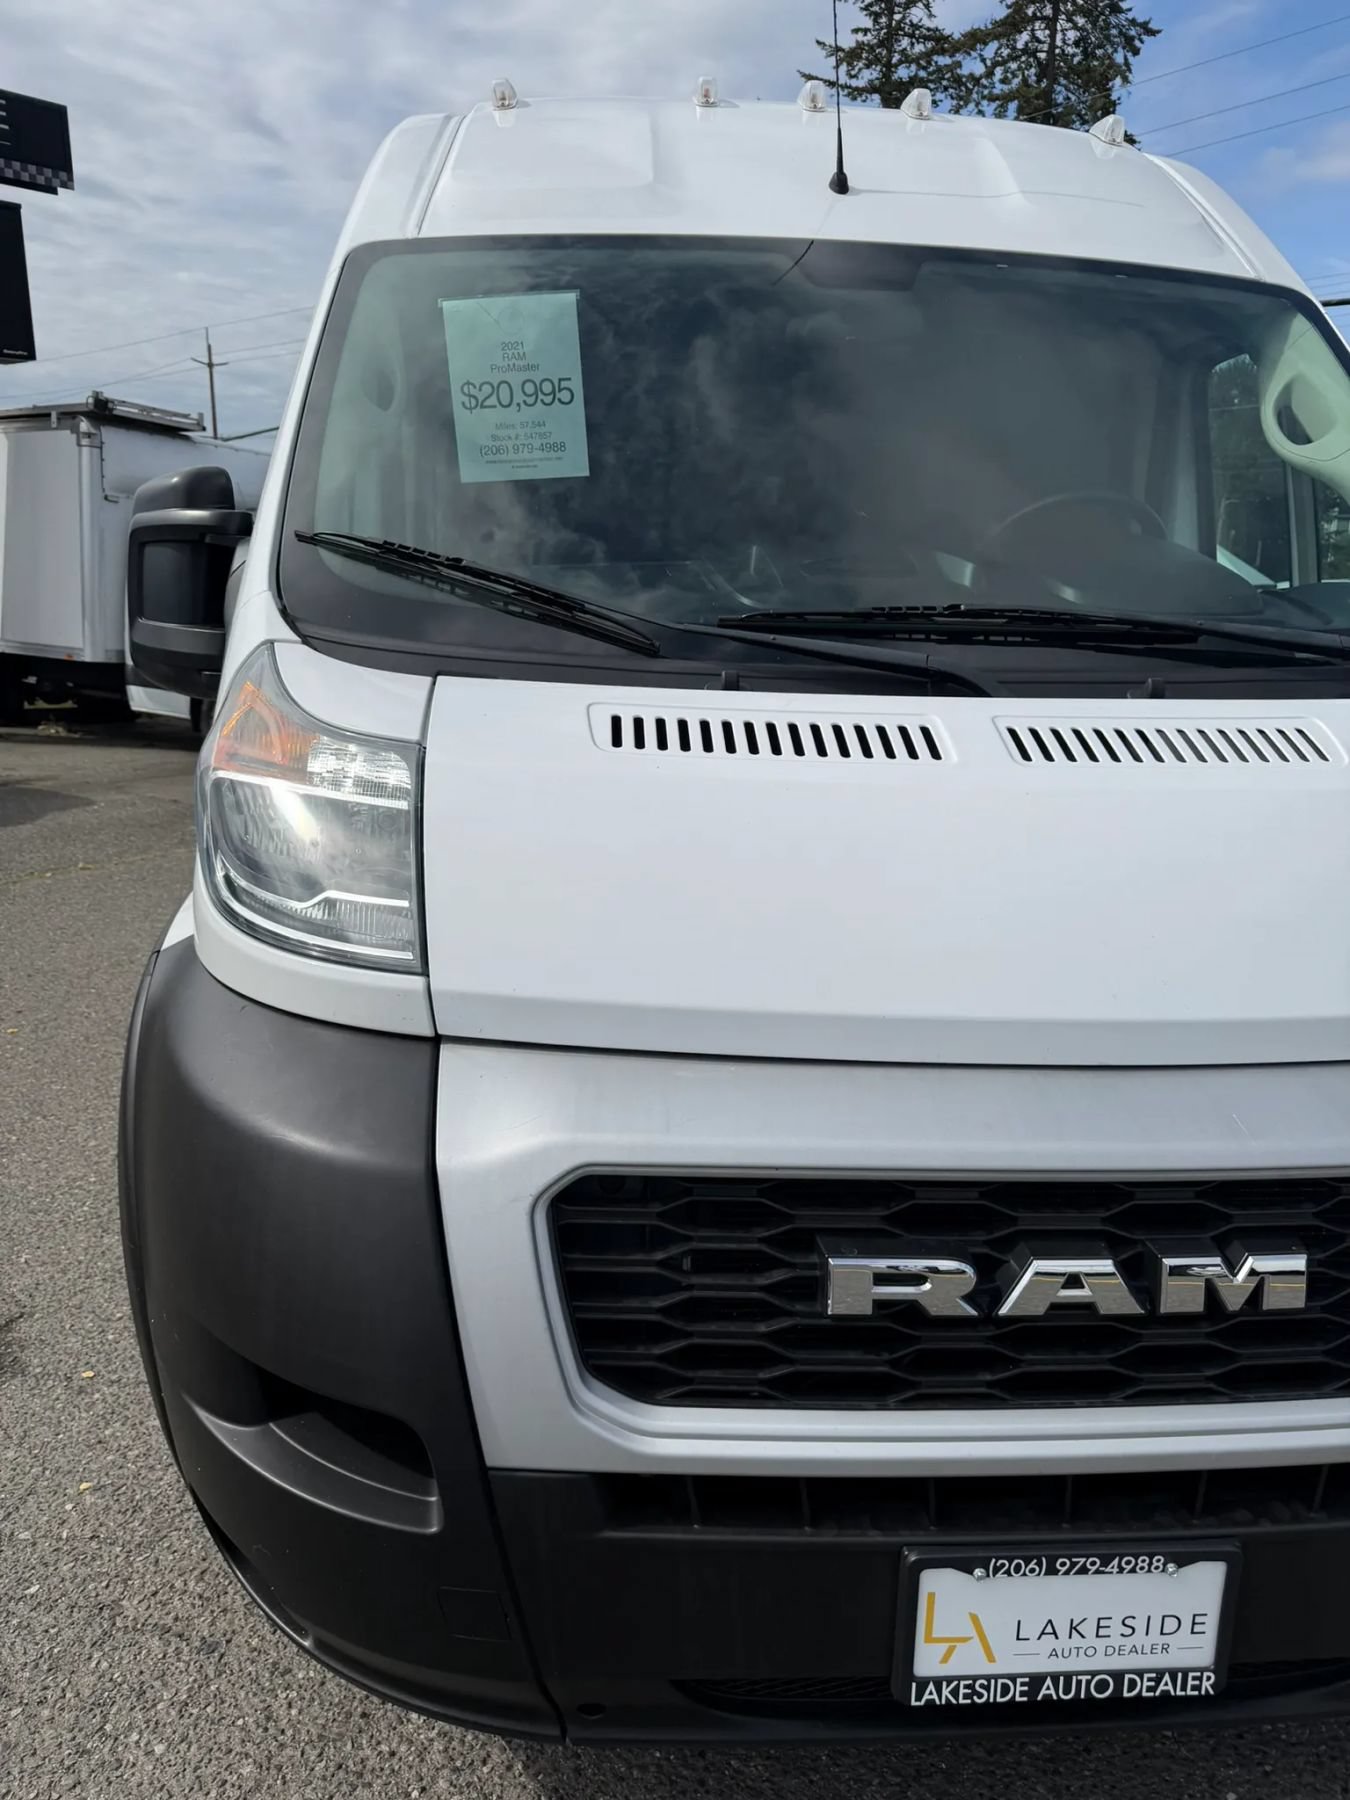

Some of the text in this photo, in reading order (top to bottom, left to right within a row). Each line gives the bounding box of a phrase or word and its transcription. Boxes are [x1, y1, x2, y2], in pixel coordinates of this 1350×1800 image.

[501, 341, 525, 351] 2021
[502, 352, 527, 362] RAM
[490, 362, 540, 374] ProMaster
[460, 377, 575, 414] $20,995
[490, 434, 512, 442] Stock
[479, 441, 567, 457] (206) 979-4988
[826, 1252, 1308, 1318] RAM
[988, 1556, 1165, 1578] (206) 979-4988
[1015, 1613, 1209, 1642] LAKESIDE
[1047, 1643, 1171, 1660] AUTO DEALER
[910, 1671, 1216, 1706] LAKESIDE AUTO DEALER
